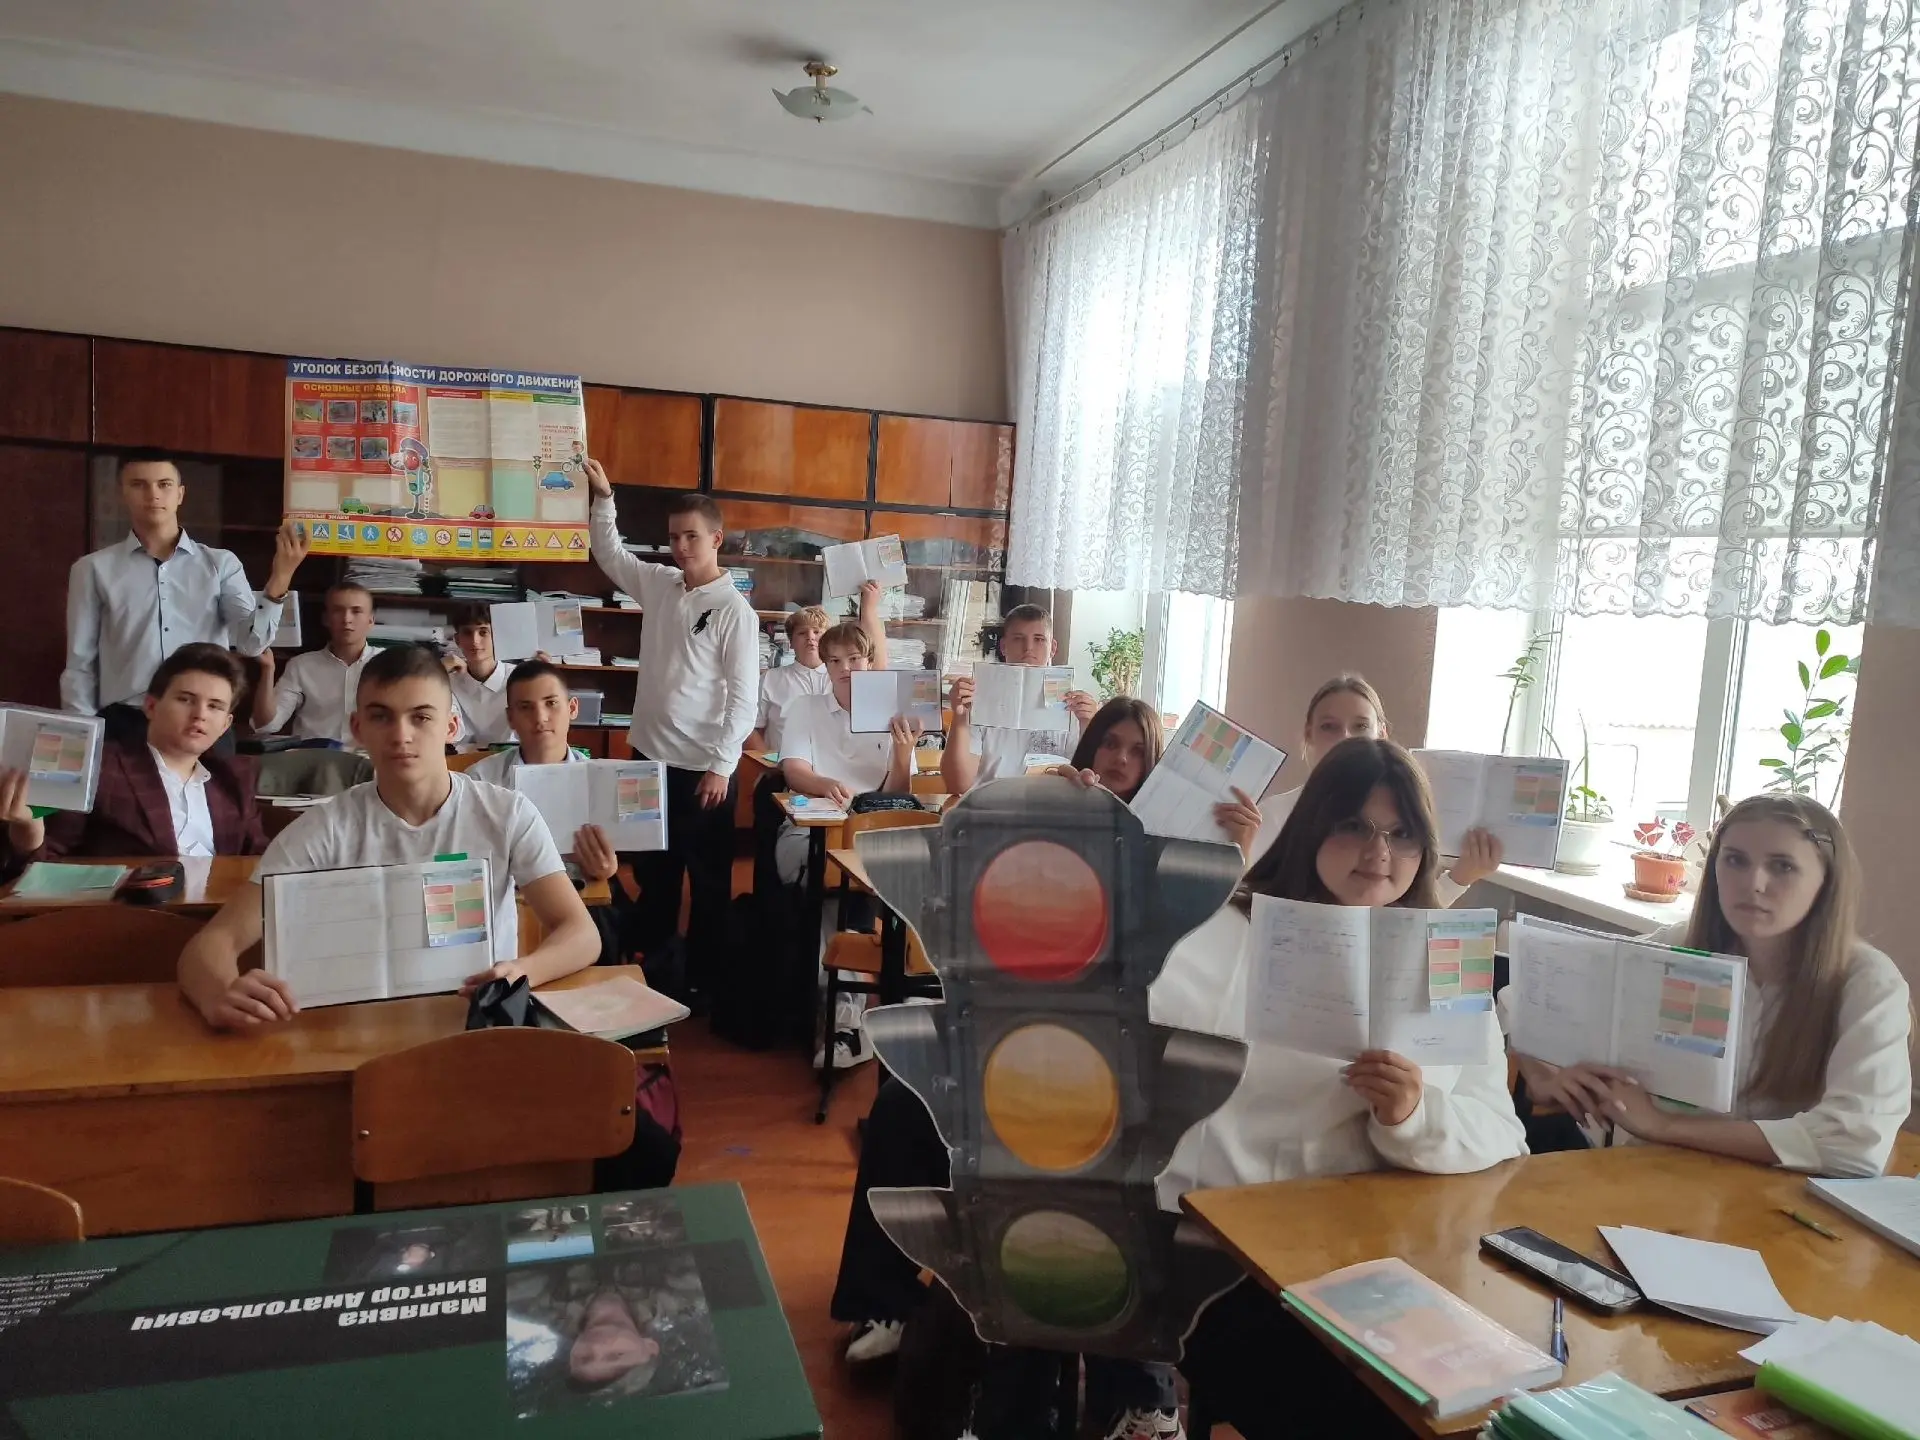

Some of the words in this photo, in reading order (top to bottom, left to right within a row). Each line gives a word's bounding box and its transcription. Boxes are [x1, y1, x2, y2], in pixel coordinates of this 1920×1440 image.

[293, 362, 341, 375] УГОЛОК
[344, 364, 436, 380] БЕЗОПАСНОСТИ
[439, 371, 514, 384] ДОРОЖНОГО
[517, 375, 581, 389] ДВИЖЕНИЯ
[303, 384, 360, 392] ОСНОВНЫЕ
[364, 384, 407, 394] ПРАВИЛА
[371, 1277, 487, 1304] Виктор
[130, 1291, 366, 1331] Анатольевич
[338, 1296, 487, 1327] Малявка
